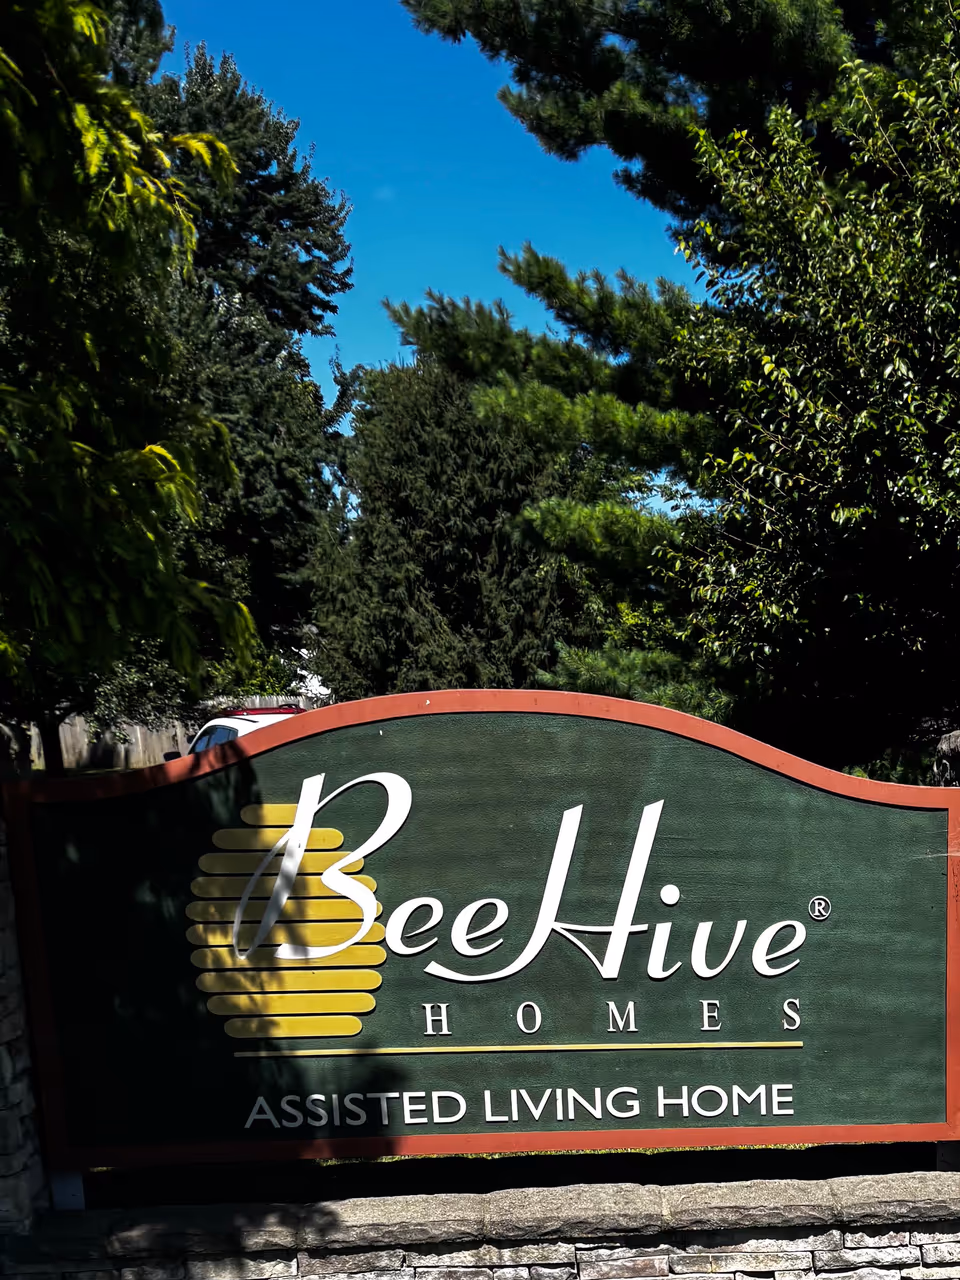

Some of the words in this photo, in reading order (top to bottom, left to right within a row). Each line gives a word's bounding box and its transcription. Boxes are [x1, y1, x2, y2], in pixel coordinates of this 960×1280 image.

[423, 998, 802, 1036] HOMES
[244, 1090, 467, 1129] ASSISTED
[484, 1086, 641, 1123] LIVING
[657, 1083, 795, 1119] HOME
